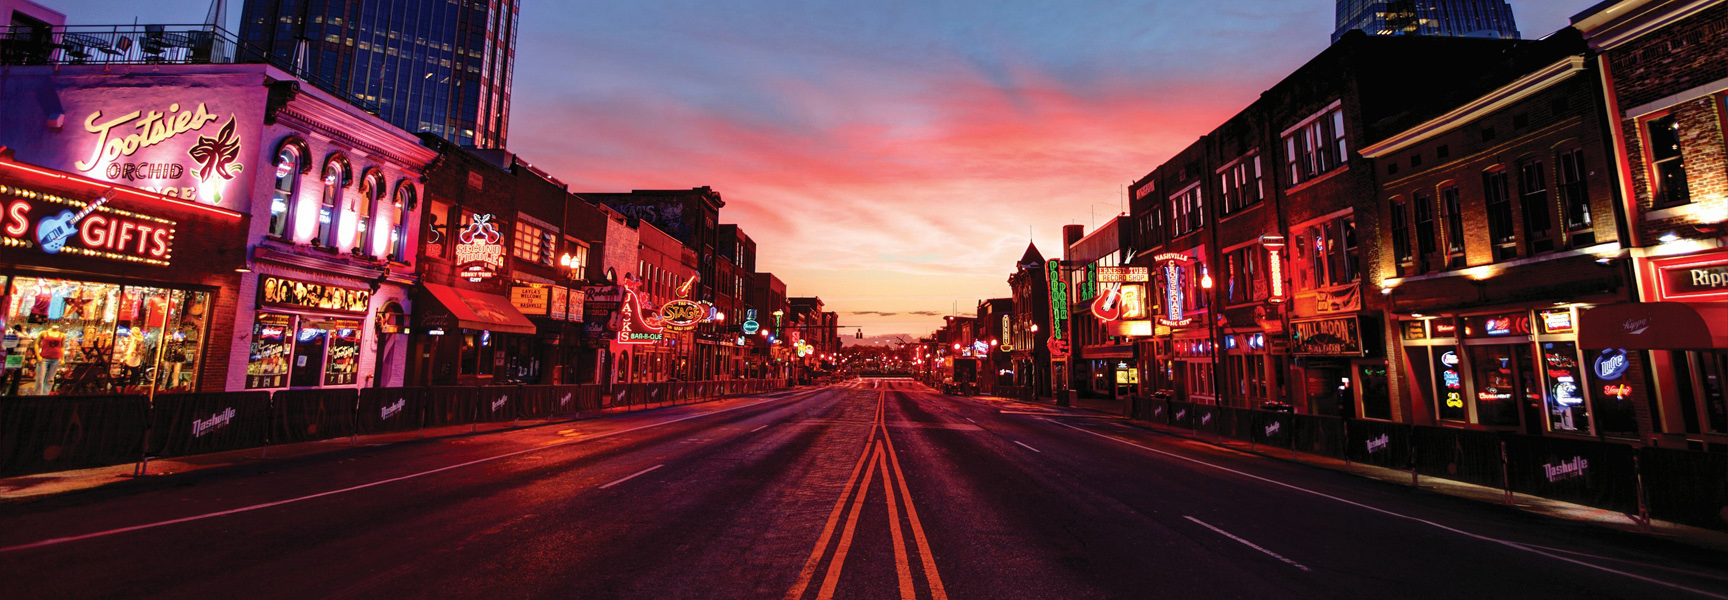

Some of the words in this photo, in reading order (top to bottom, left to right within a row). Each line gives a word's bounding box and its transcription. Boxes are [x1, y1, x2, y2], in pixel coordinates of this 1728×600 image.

[75, 102, 218, 172] Tootsies
[106, 162, 184, 181] ORCHID
[81, 214, 167, 257] GIFTS
[456, 244, 501, 256] SECOND
[1154, 253, 1187, 261] NASHVILLE
[1129, 266, 1148, 274] TUBB
[663, 304, 700, 321] STAGE
[1297, 322, 1318, 345] FULL
[1319, 319, 1350, 344] MOON
